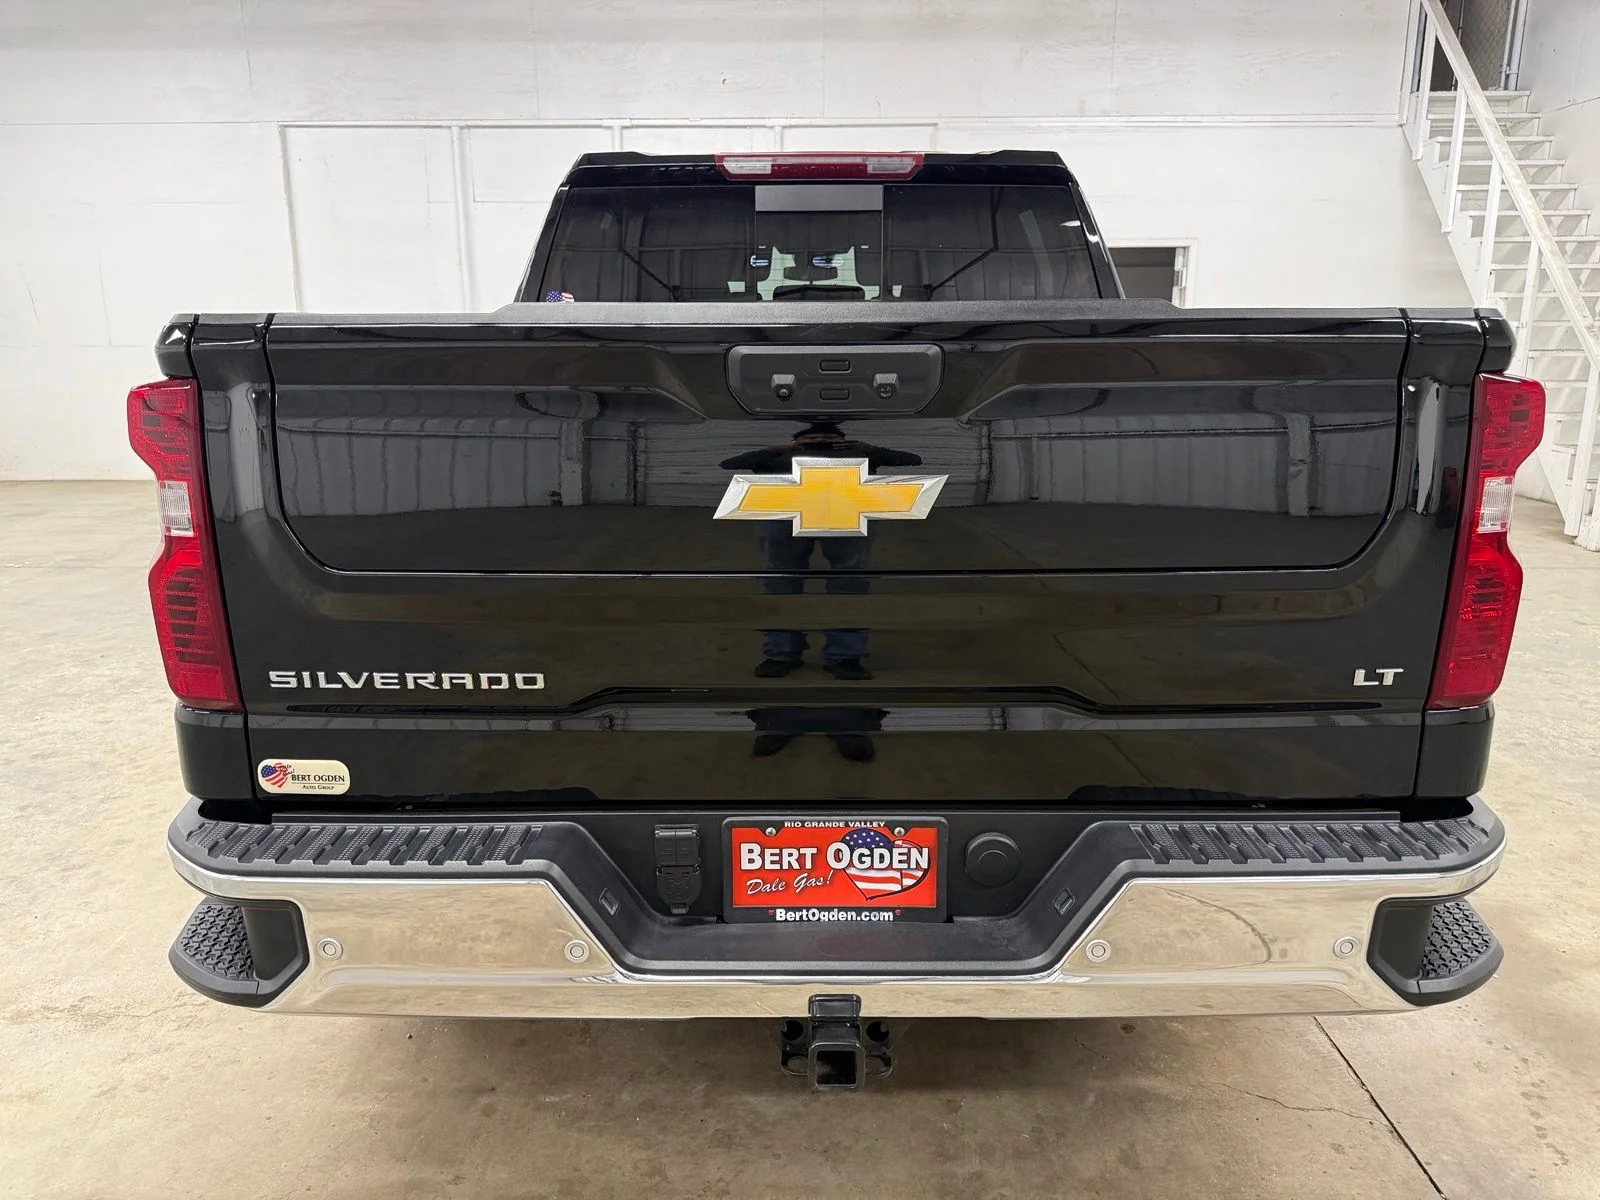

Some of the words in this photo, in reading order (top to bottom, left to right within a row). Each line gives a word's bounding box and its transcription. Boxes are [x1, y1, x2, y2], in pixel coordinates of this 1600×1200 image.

[268, 670, 546, 691] SILVERADO
[1353, 668, 1404, 686] LT
[291, 774, 311, 783] BERT
[313, 774, 345, 783] OGDEN
[740, 842, 818, 870] BERT
[826, 841, 929, 870] OGDEN
[746, 877, 786, 895] Dale
[793, 869, 834, 894] Gas!
[775, 908, 894, 922] BertOgden.com
